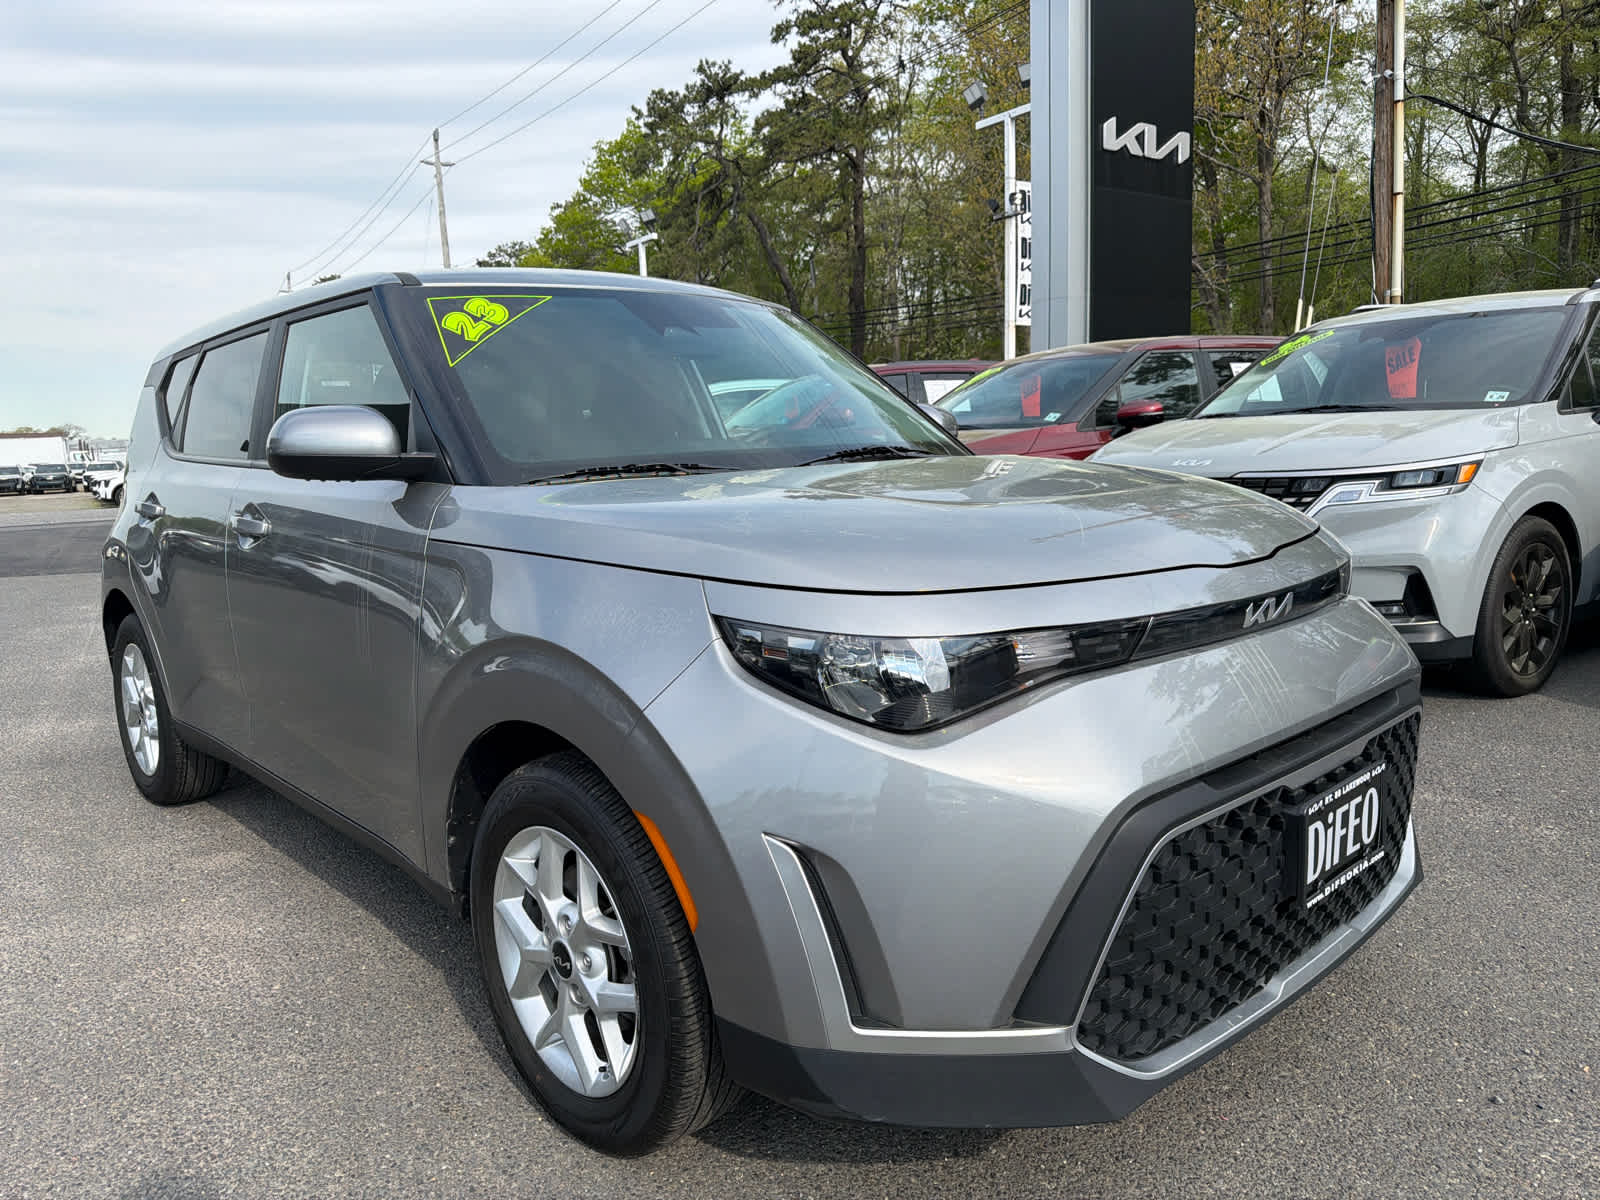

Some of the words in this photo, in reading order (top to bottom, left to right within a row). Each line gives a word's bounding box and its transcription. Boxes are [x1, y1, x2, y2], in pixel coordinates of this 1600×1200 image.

[1103, 116, 1190, 164] KIA
[441, 297, 510, 342] 23
[1387, 345, 1417, 375] SALE
[1243, 592, 1294, 629] KIA
[1306, 787, 1379, 885] DiFEO
